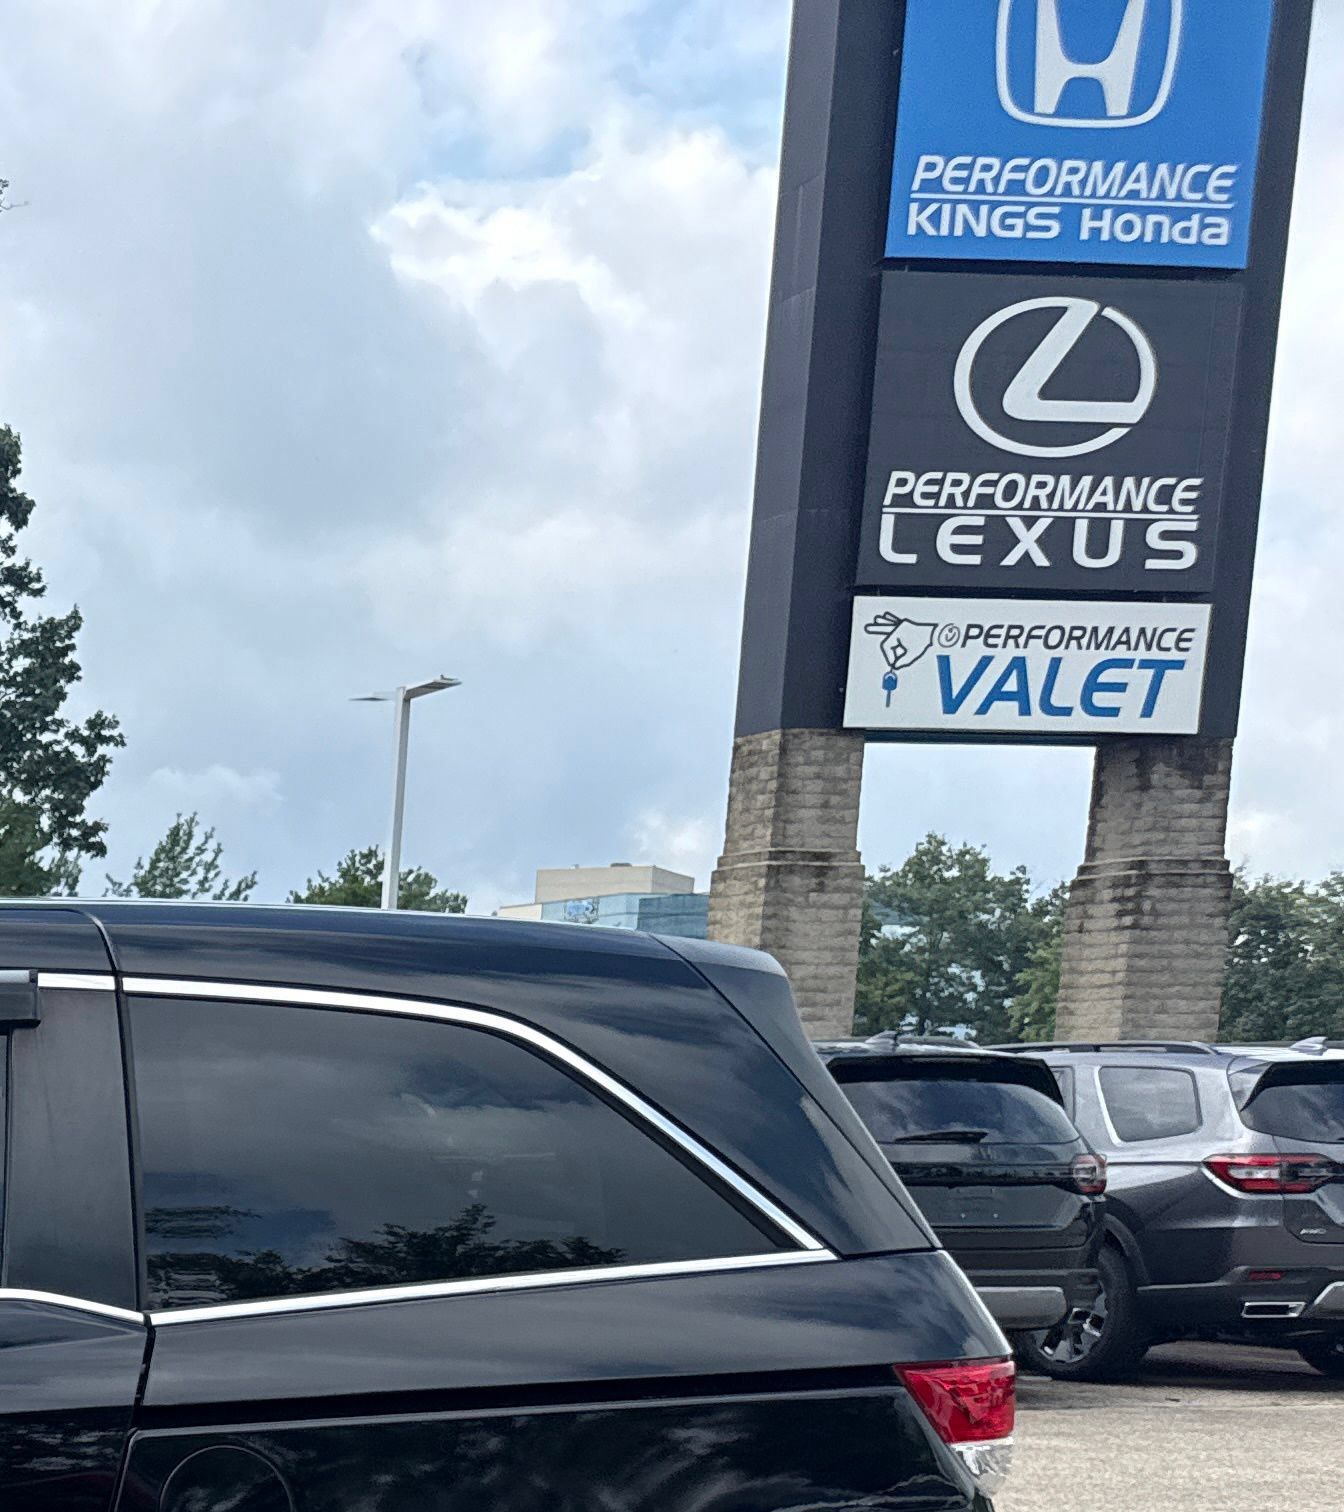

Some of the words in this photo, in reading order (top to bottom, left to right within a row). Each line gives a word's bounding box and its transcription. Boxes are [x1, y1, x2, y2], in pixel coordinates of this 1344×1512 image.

[911, 155, 1239, 202] PERFORMANCE
[906, 202, 1061, 241] KINGS
[1079, 208, 1230, 246] Honda
[882, 470, 1205, 514] PERFORMANCE
[878, 514, 1199, 570] LEXUS
[960, 623, 1196, 654] PERFORMANCE
[935, 654, 1186, 719] VALET
